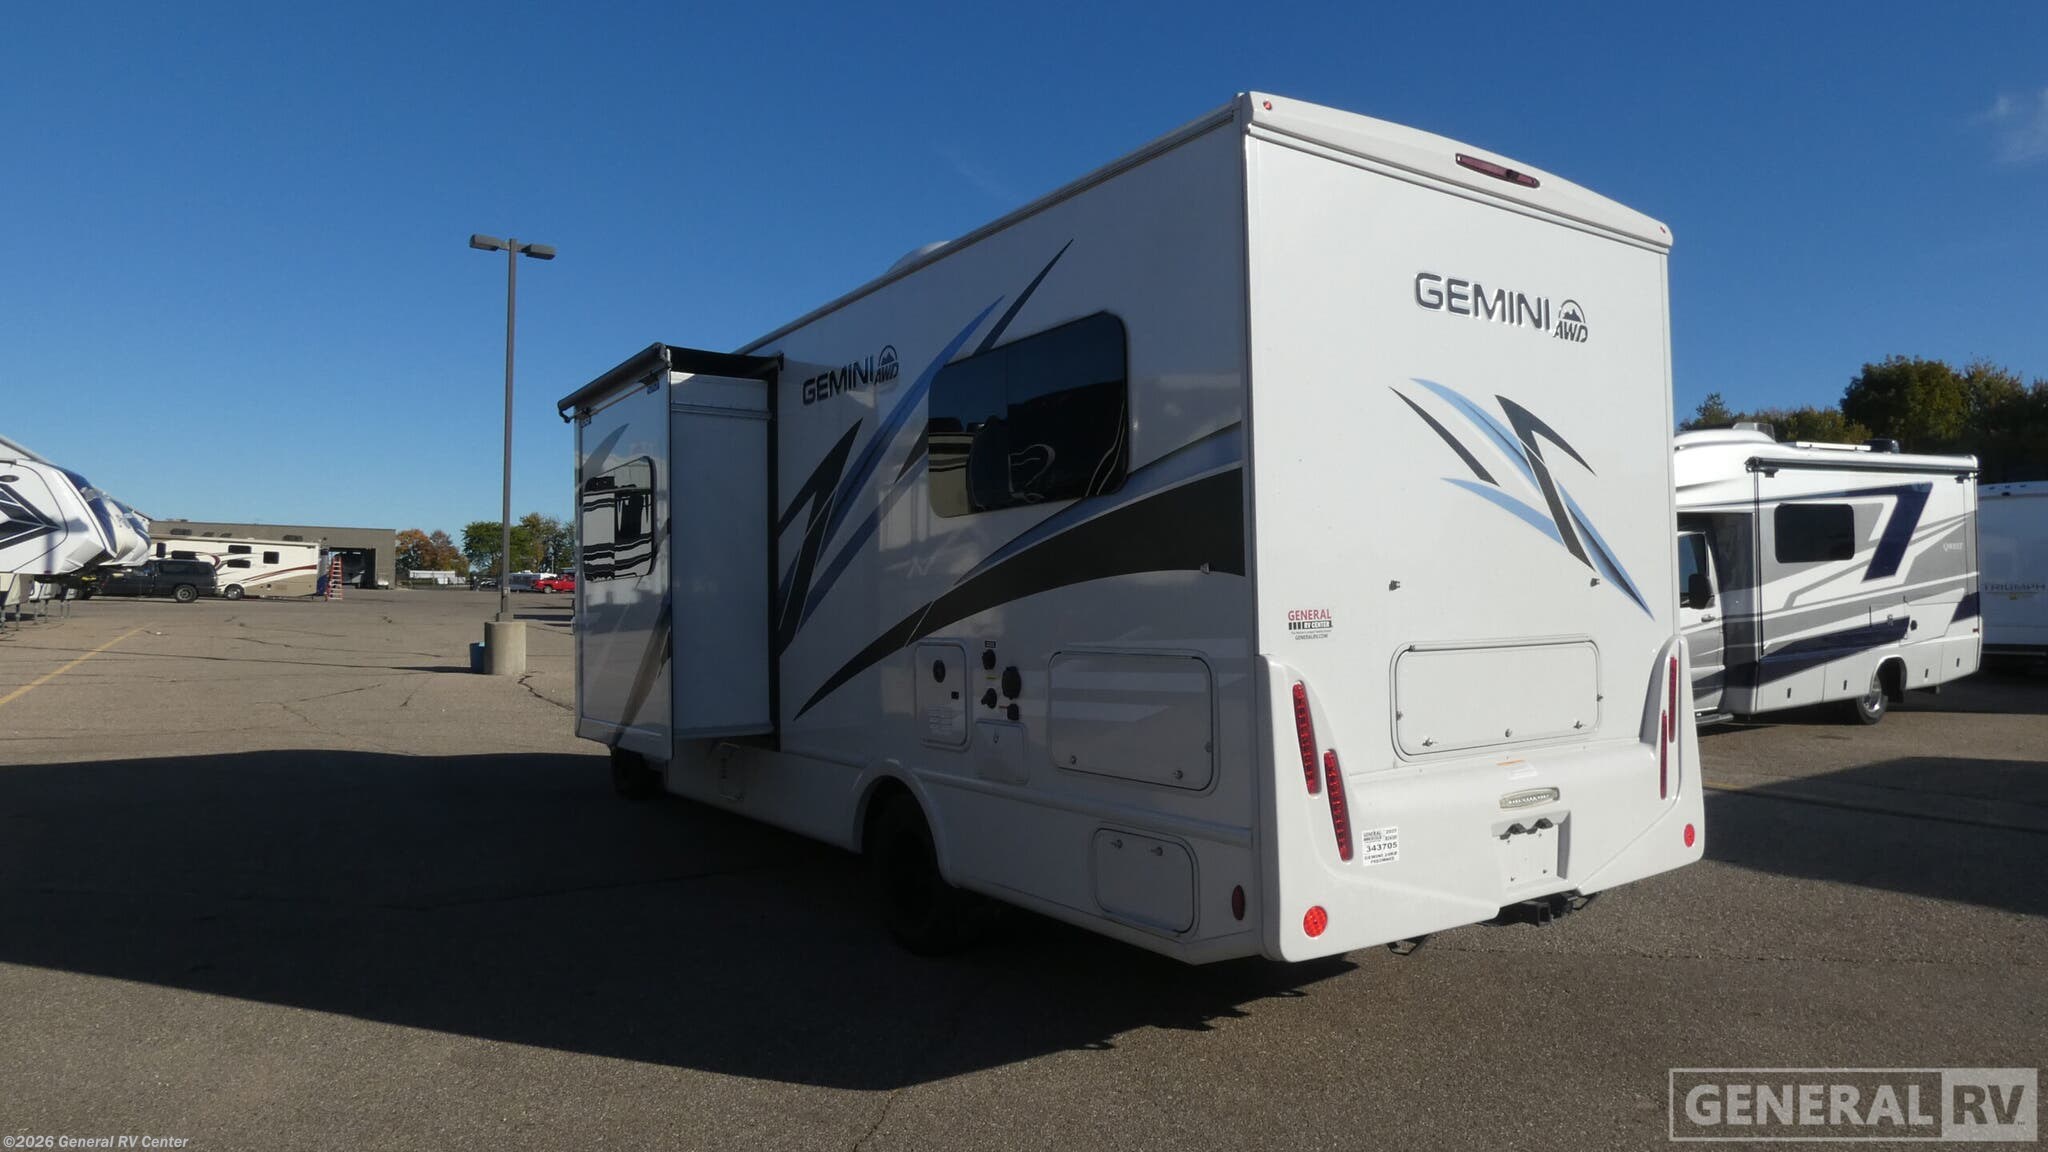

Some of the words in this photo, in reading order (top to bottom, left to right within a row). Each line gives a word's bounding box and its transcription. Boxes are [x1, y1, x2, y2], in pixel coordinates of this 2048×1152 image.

[1415, 272, 1551, 330] GEMINI
[1553, 320, 1588, 343] AWD
[802, 355, 874, 405] GEMINI
[874, 361, 900, 385] AWD
[1981, 583, 2047, 592] TRIUMPH
[1288, 609, 1332, 621] GENERAL
[1366, 841, 1398, 853] 343705
